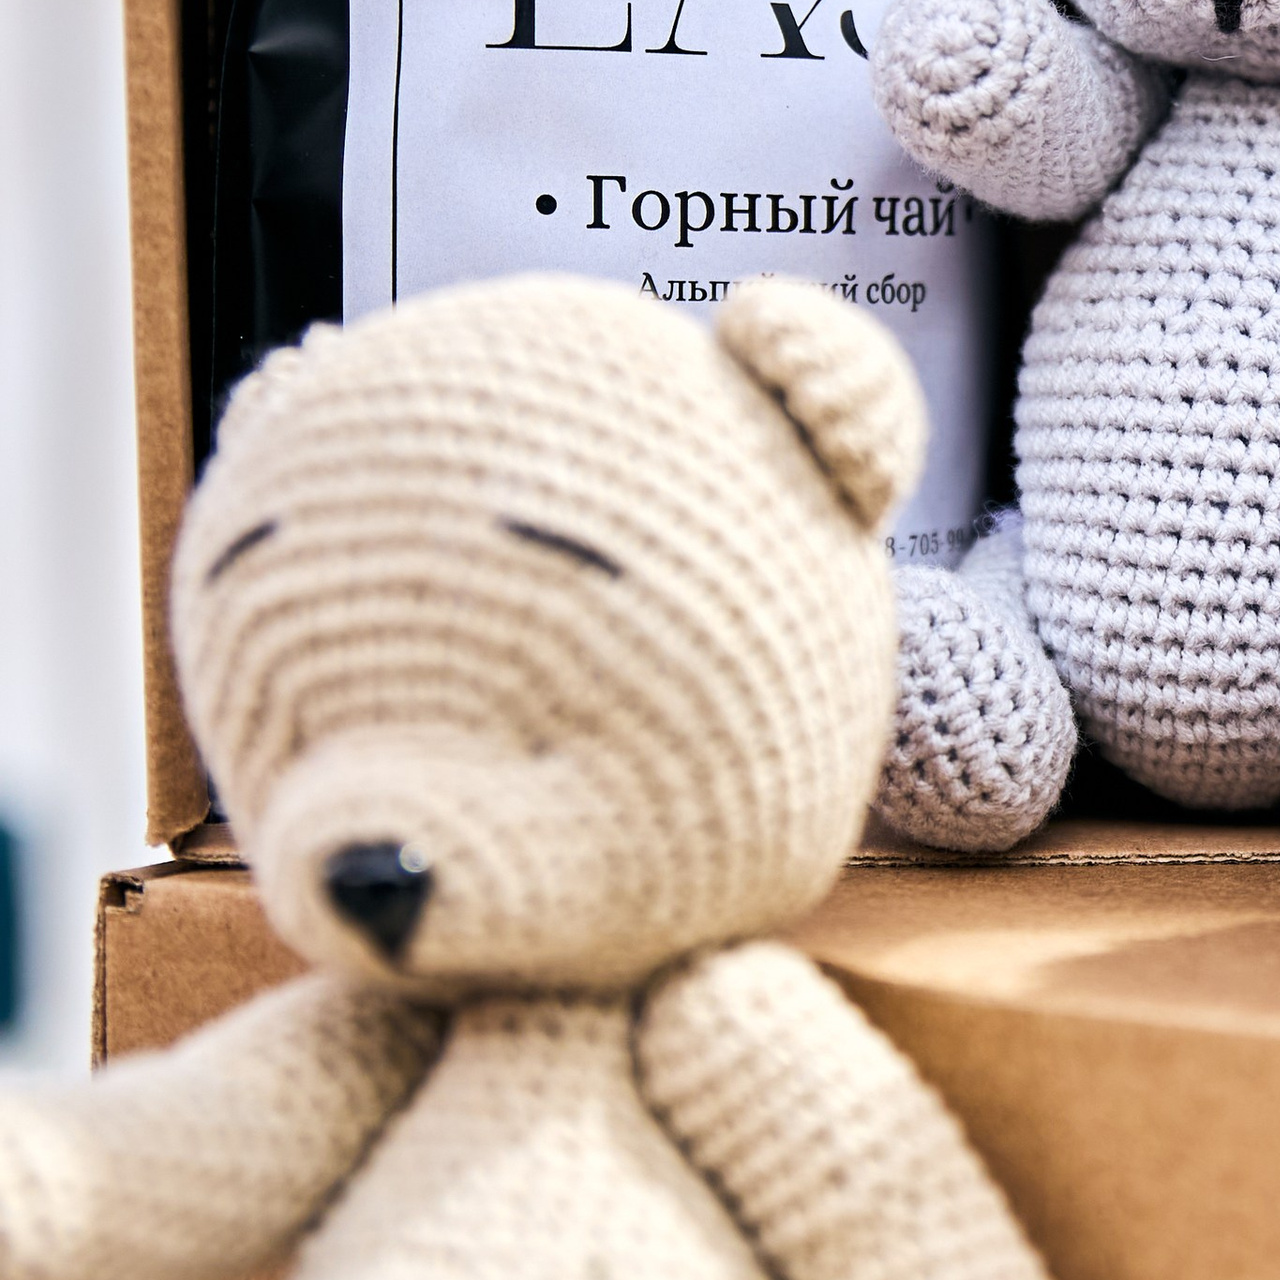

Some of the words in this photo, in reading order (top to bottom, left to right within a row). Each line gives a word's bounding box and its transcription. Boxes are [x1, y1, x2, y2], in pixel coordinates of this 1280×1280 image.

[586, 174, 858, 247] Горный
[872, 179, 955, 236] чай
[866, 273, 926, 312] сбор
